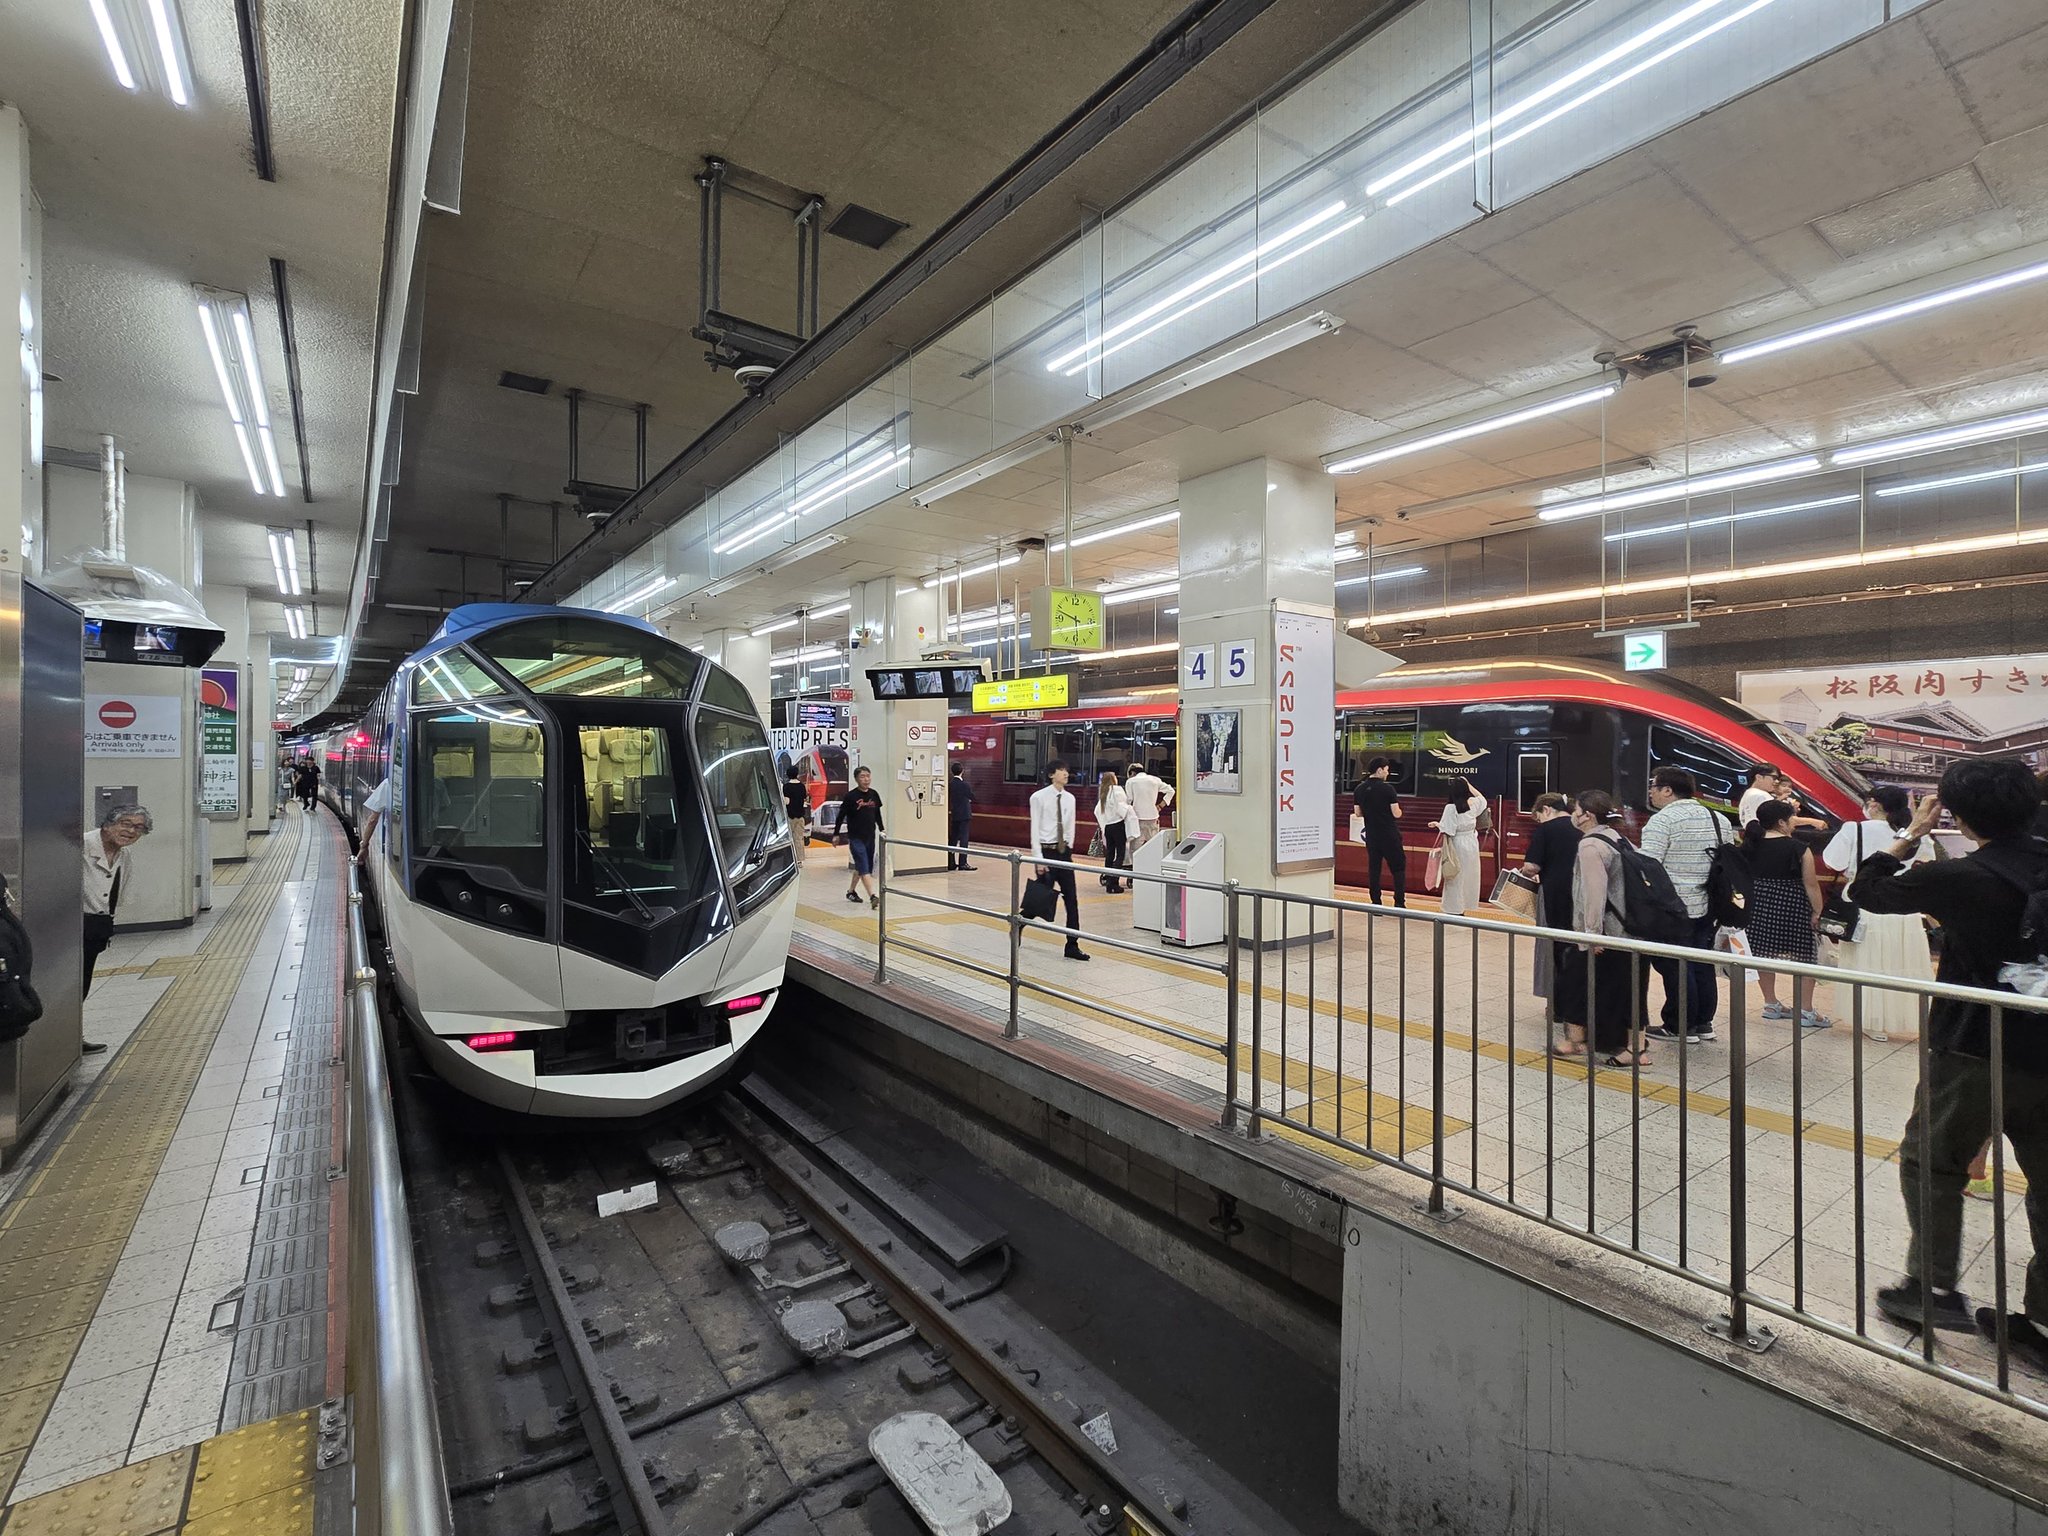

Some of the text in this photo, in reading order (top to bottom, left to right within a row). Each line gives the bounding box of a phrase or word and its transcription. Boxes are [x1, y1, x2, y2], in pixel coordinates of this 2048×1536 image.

[1071, 597, 1080, 606] 12
[1058, 614, 1064, 623] 9
[1087, 617, 1093, 625] 3
[1072, 634, 1079, 643] 6
[1191, 648, 1245, 681] 4 5
[1825, 666, 2048, 699] 松阪肉すき
[126, 741, 145, 749] only
